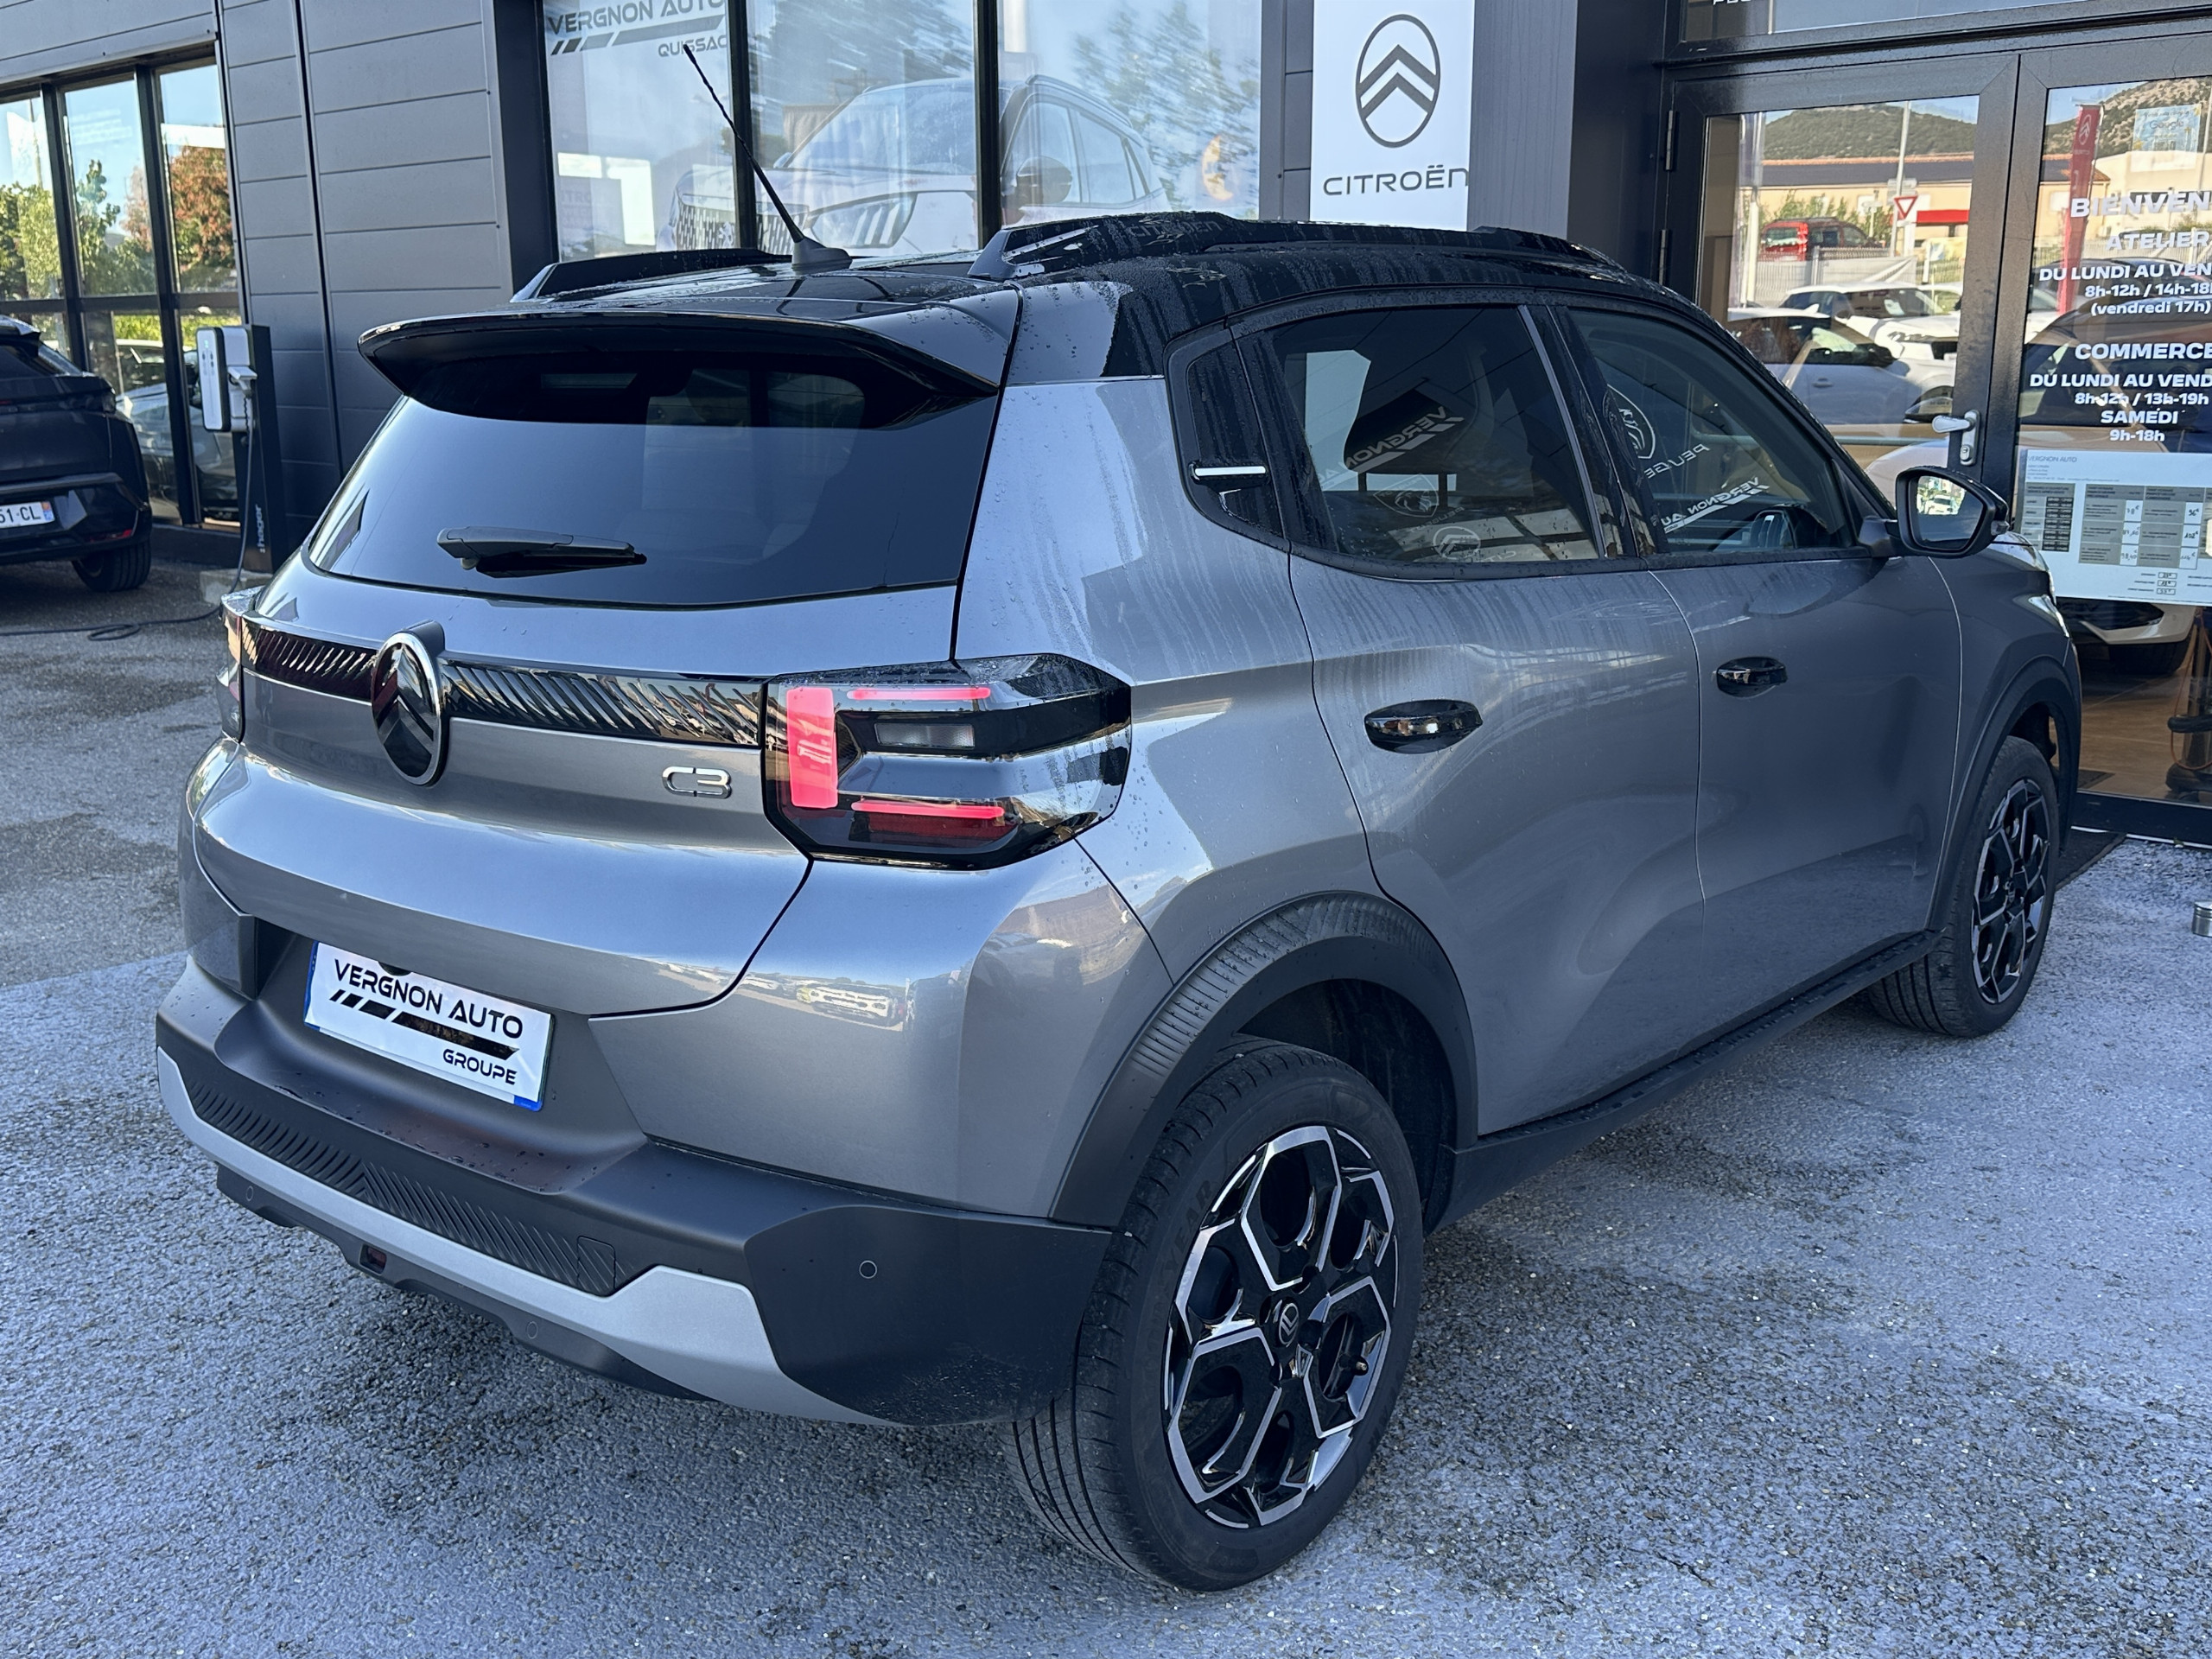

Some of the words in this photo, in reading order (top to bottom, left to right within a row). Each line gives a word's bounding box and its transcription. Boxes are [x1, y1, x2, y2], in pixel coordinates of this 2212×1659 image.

[548, 0, 653, 35] VERGNON
[1323, 164, 1469, 196] CITROËN
[2070, 191, 2210, 218] BIENVEN
[2105, 231, 2210, 251] ATELIER
[2039, 268, 2068, 282] DU
[2071, 265, 2131, 281] LUNDI
[2133, 264, 2164, 278] AU
[2085, 284, 2140, 297] 8h-12h
[2143, 283, 2152, 298] /
[2091, 301, 2171, 316] (vendredi
[2175, 299, 2211, 315] 17h)
[2030, 373, 2058, 387] DU
[2061, 373, 2120, 387] LUNDI
[2123, 373, 2154, 388] AU
[2158, 373, 2212, 388] VEND
[2075, 391, 2130, 405] 8h-12h
[2132, 392, 2141, 407] /
[2144, 392, 2209, 406] 13h-19h
[2100, 410, 2178, 424] SAMEDI
[2109, 429, 2165, 442] 9h-18h
[662, 766, 733, 799] C3
[334, 957, 443, 1015] VERGNON
[448, 999, 523, 1039] AUTO
[442, 1048, 518, 1086] GROUPE
